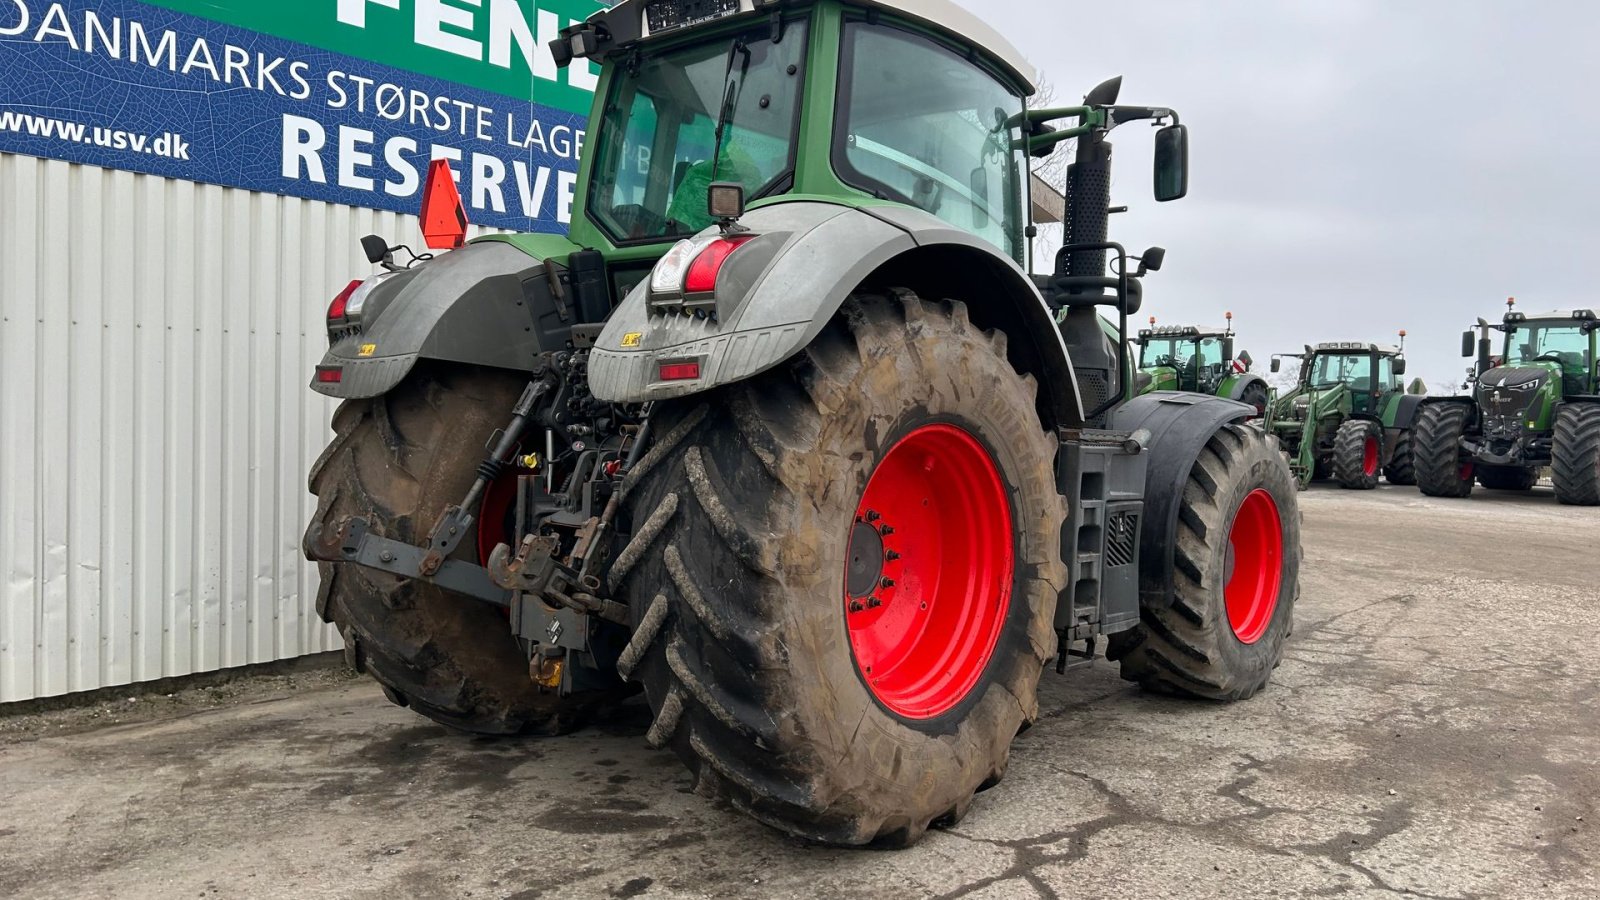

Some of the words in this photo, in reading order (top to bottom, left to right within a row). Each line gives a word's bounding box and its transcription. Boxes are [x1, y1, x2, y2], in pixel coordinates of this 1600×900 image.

[0, 0, 311, 100] DANMARKS
[327, 70, 493, 142] STØRSTE
[0, 111, 190, 161] www.usv.dk
